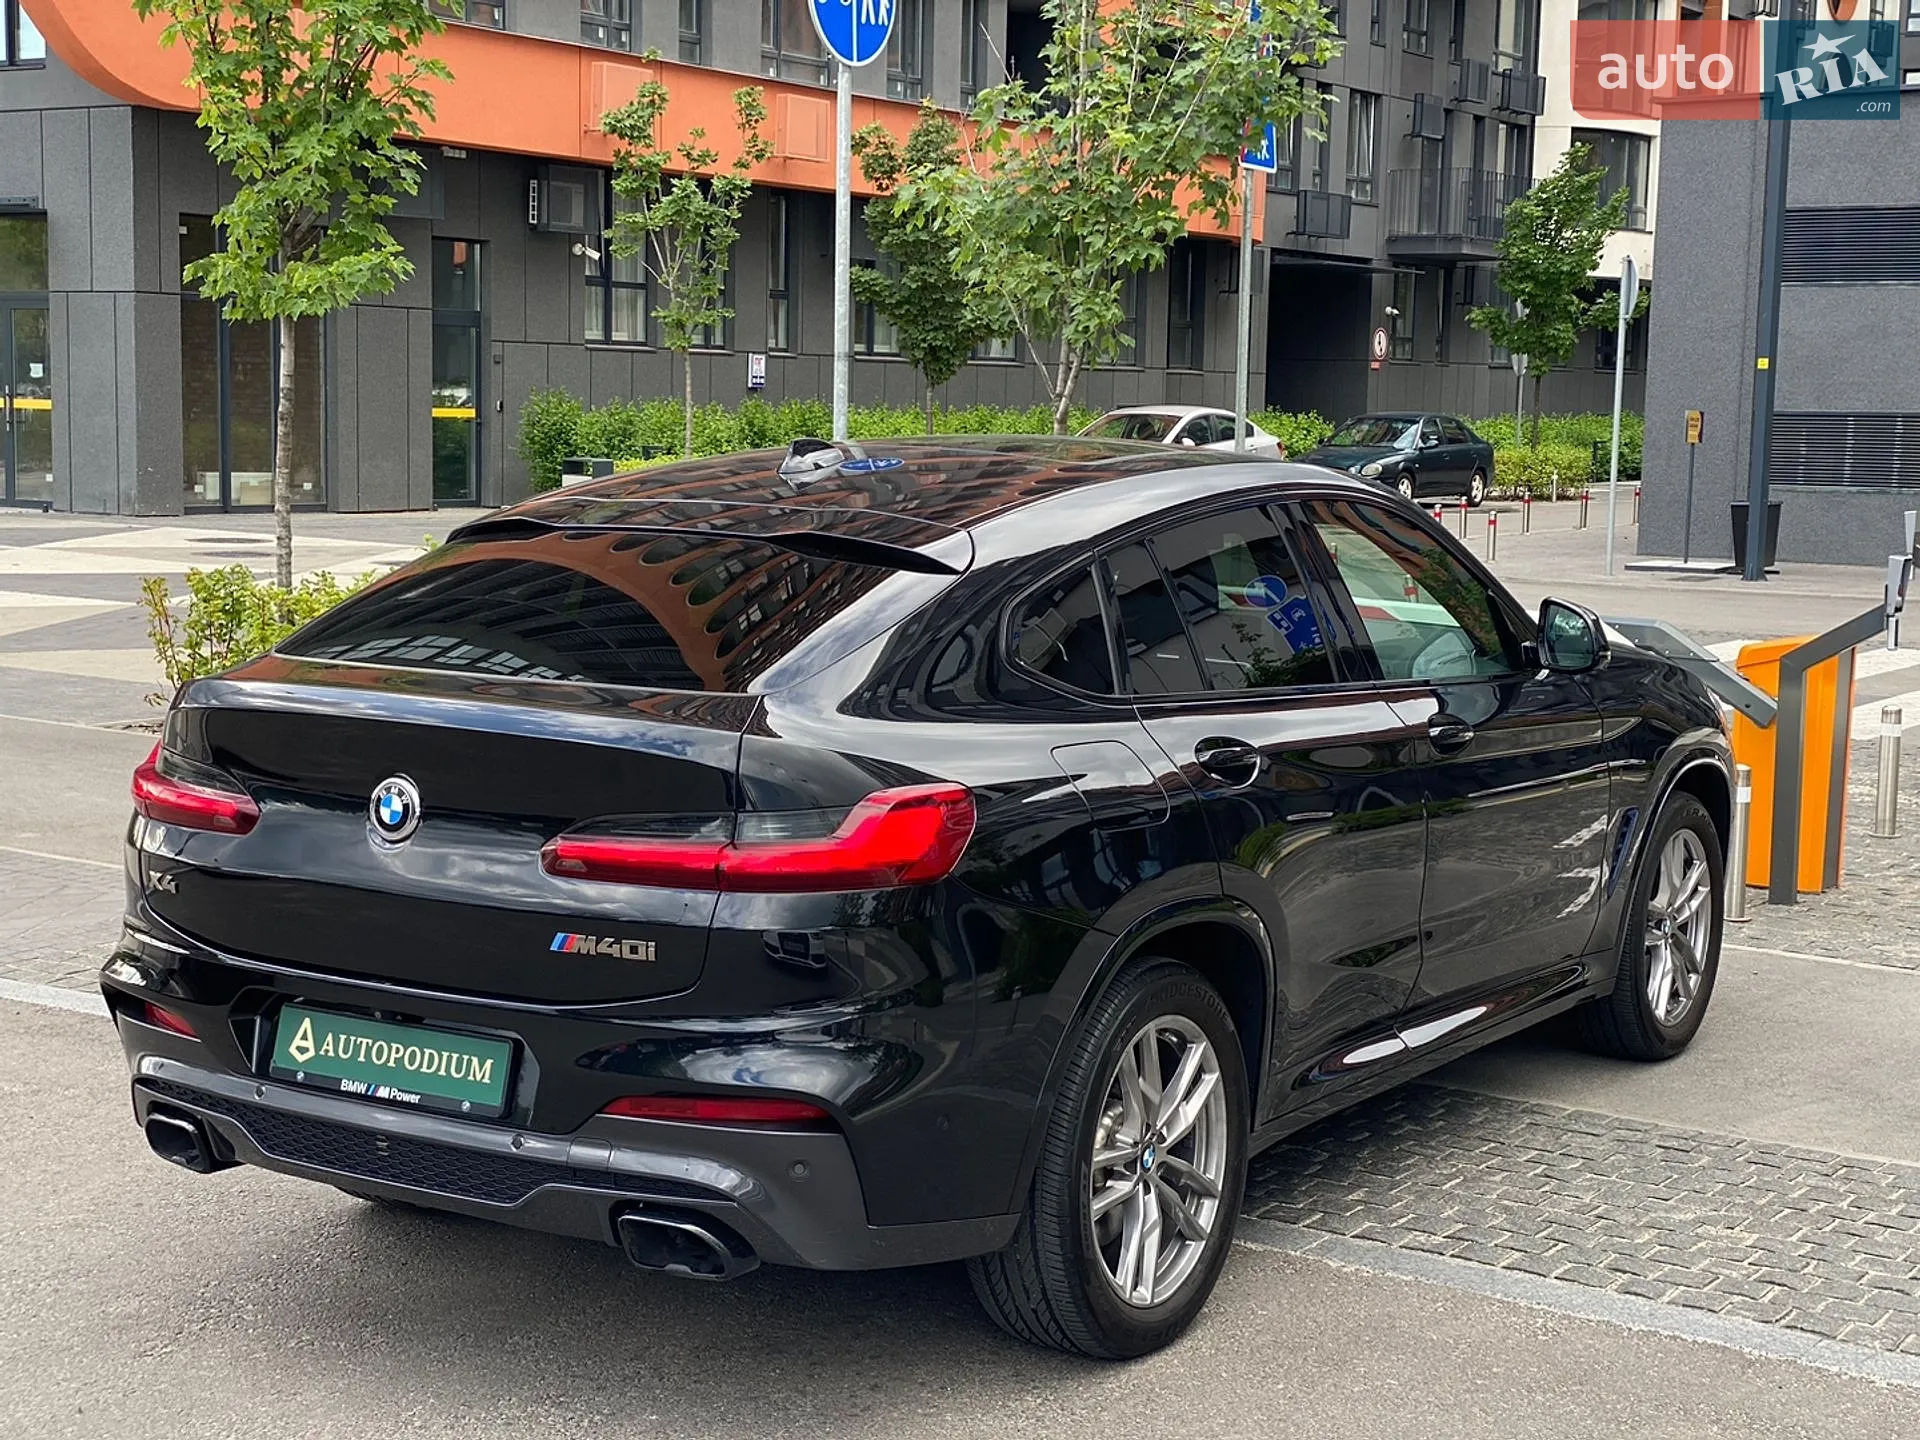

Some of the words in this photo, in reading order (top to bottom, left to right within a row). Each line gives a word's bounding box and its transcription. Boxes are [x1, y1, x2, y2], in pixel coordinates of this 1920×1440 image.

[148, 870, 177, 895] X4
[319, 1032, 494, 1084] AUTOPODIUM
[340, 1078, 367, 1095] BMW
[390, 1087, 421, 1104] Power
